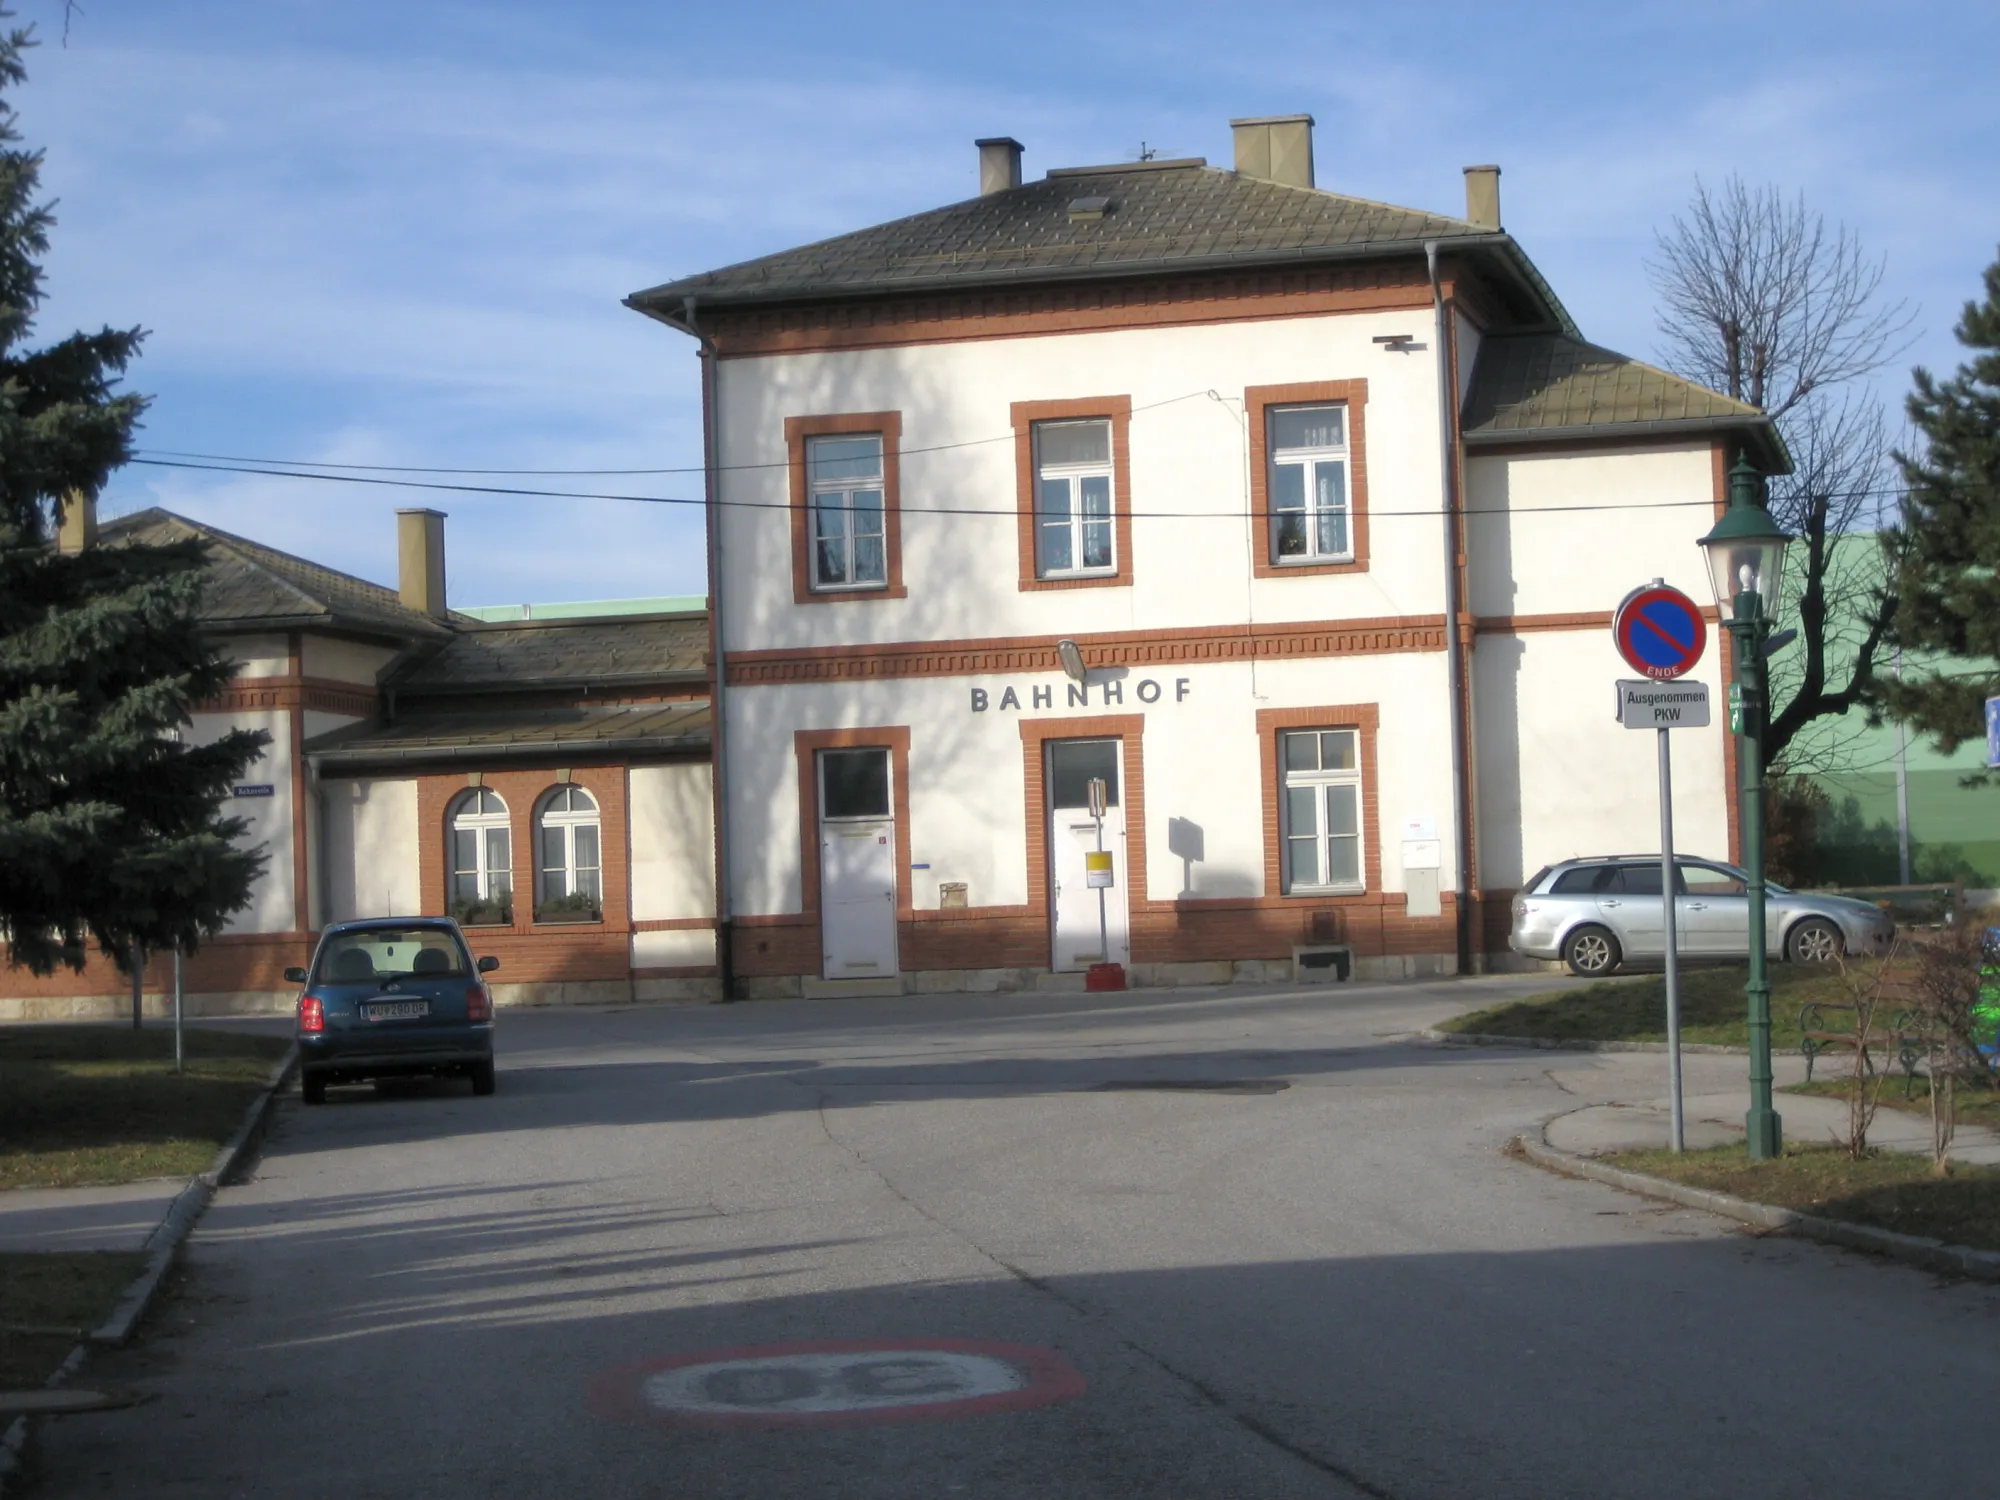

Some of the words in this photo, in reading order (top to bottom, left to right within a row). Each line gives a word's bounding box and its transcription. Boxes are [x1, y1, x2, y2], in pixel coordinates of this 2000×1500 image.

[1647, 665, 1680, 677] ENDE
[971, 677, 1191, 712] BAHNHOF
[1626, 691, 1707, 706] Ausgenommen
[1653, 707, 1682, 721] PKW
